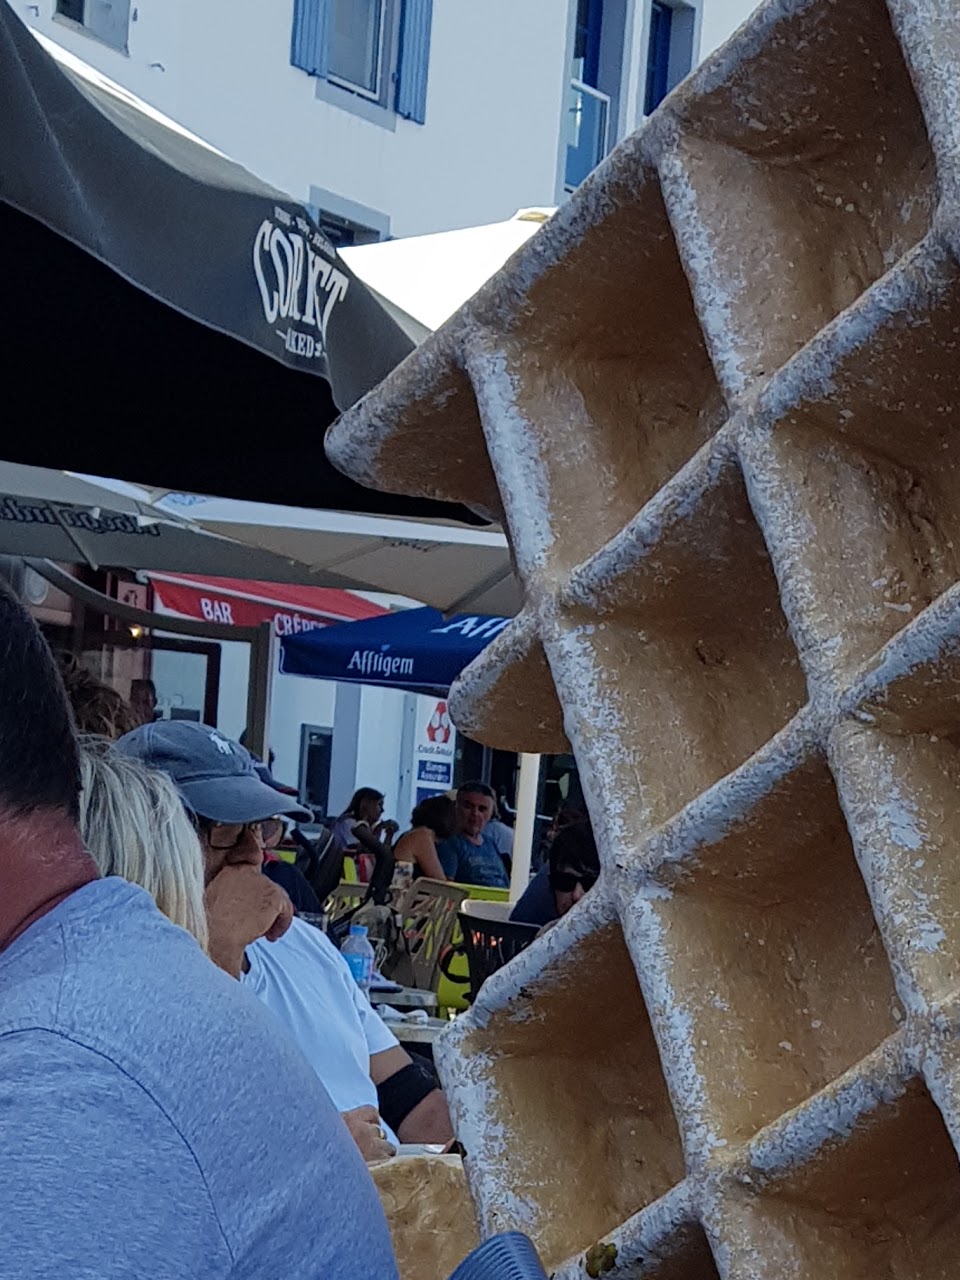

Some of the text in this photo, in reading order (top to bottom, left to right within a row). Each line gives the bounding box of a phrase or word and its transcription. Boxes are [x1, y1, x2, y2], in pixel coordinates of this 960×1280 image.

[200, 598, 235, 625] BAR
[430, 617, 514, 639] Aff
[346, 650, 414, 677] Affligem
